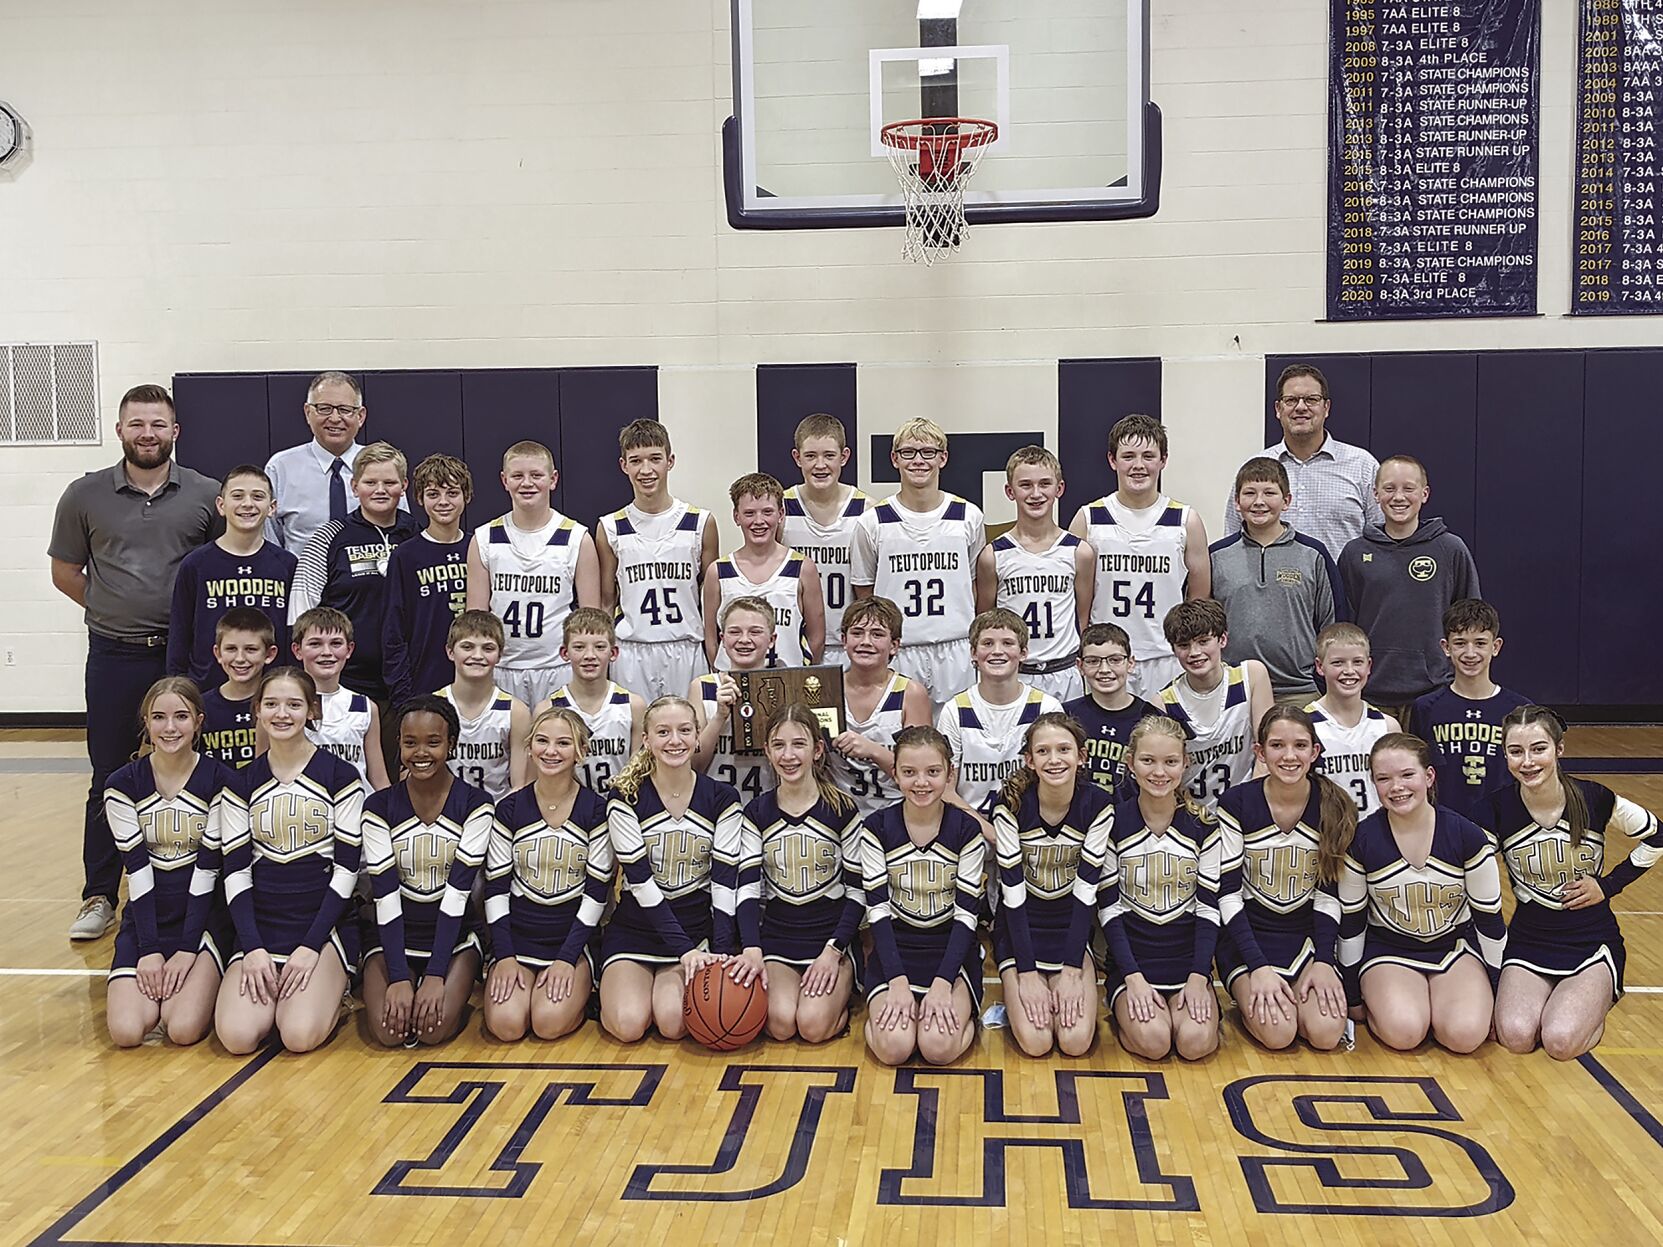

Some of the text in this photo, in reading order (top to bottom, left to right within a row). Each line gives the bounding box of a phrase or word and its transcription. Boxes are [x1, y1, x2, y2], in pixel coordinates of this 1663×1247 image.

[1345, 7, 1460, 20] 1995 7AA ELITE 8
[1587, 14, 1619, 26] 1989
[1346, 23, 1460, 36] 1997 7AA ELITE 8
[1585, 30, 1617, 42] 2001
[1345, 38, 1469, 52] 2008 7-3A ELITE 8
[1585, 47, 1618, 58] 2002
[1624, 46, 1650, 56] 8AA
[1345, 52, 1487, 67] 2009 8-3A 4th PLACE
[1346, 67, 1529, 82] 2010 7-3A STATE CHAMPIONS
[1584, 63, 1617, 74] 2003
[1346, 82, 1529, 97] 2011 7-3A STATE CHAMPIONS
[1584, 78, 1617, 89] 2004
[1623, 77, 1650, 87] 7AA
[1584, 91, 1654, 104] 2009 8-3A
[1346, 98, 1527, 114] 2011 8-3A STATE RUNNER-UP
[1584, 106, 1653, 118] 2010 8-3A
[1345, 114, 1529, 129] 2013 7-3A STATE CHAMPIONS
[1583, 121, 1654, 133] 2011 8-3A
[1345, 130, 1527, 144] 2013 8-3A STATE RUNNER-UP
[1582, 137, 1654, 150] 2012 8-3A
[1344, 145, 1530, 160] 2015 7-3A STATE RUNNER UP
[1583, 151, 1654, 164] 2013 7-3A
[1344, 163, 1460, 176] 2015 8-3A ELITE 8
[1581, 166, 1654, 178] 2014 7-3A
[1344, 176, 1535, 192] 2016 7-3A STATE CHAMPIONS
[1581, 182, 1654, 194] 2014 8-3A
[1344, 192, 1535, 207] 2016 8-3A STATE CHAMPIONS
[1581, 199, 1653, 210] 2015 7-3A
[1344, 208, 1535, 222] 2017 8-3A STATE CHAMPIONS
[1580, 214, 1654, 226] 2015 8-3A
[1344, 224, 1526, 238] 2018 7-3A STATE RUNNER UP
[1580, 229, 1655, 240] 2016 7-3A
[1344, 241, 1473, 253] 2019 7-3A ELITE 8
[1580, 244, 1612, 254] 2017
[1623, 243, 1652, 254] 7-3A
[1343, 255, 1533, 269] 2019 8-3A STATE CHAMPIONS
[1579, 260, 1612, 270] 2017
[1622, 259, 1652, 270] 8-3A
[1342, 273, 1466, 285] 2020 7-3A ELITE 8
[1580, 275, 1609, 285] 2018
[1622, 274, 1652, 285] 8-3A
[1342, 288, 1476, 301] 2020 8-3A 3rd PLACE
[1580, 291, 1610, 302] 2019
[1622, 290, 1652, 301] 7-3A
[889, 552, 958, 572] TEUTOPOLIS
[1100, 554, 1170, 574] TEUTOPOLIS
[625, 562, 692, 583] TEUTOPOLIS
[206, 578, 286, 597] WOODEN
[494, 573, 561, 594] TEUTOPOLIS
[1004, 574, 1070, 596] TEUTOPOLIS
[206, 596, 286, 609] SHOES
[904, 578, 944, 618] 32
[1112, 580, 1156, 618] 54
[640, 588, 684, 626] 45
[503, 600, 544, 638] 40
[1024, 601, 1055, 639] 41
[583, 762, 611, 793] 12
[848, 768, 886, 798] 31
[250, 793, 328, 852] TJHS
[644, 830, 712, 886] TJHS
[764, 833, 836, 892] TJHS
[513, 836, 588, 896] TJHS
[1120, 850, 1199, 912] TJHS
[1374, 882, 1465, 934] TJHS
[370, 1062, 1516, 1216] TJHS
